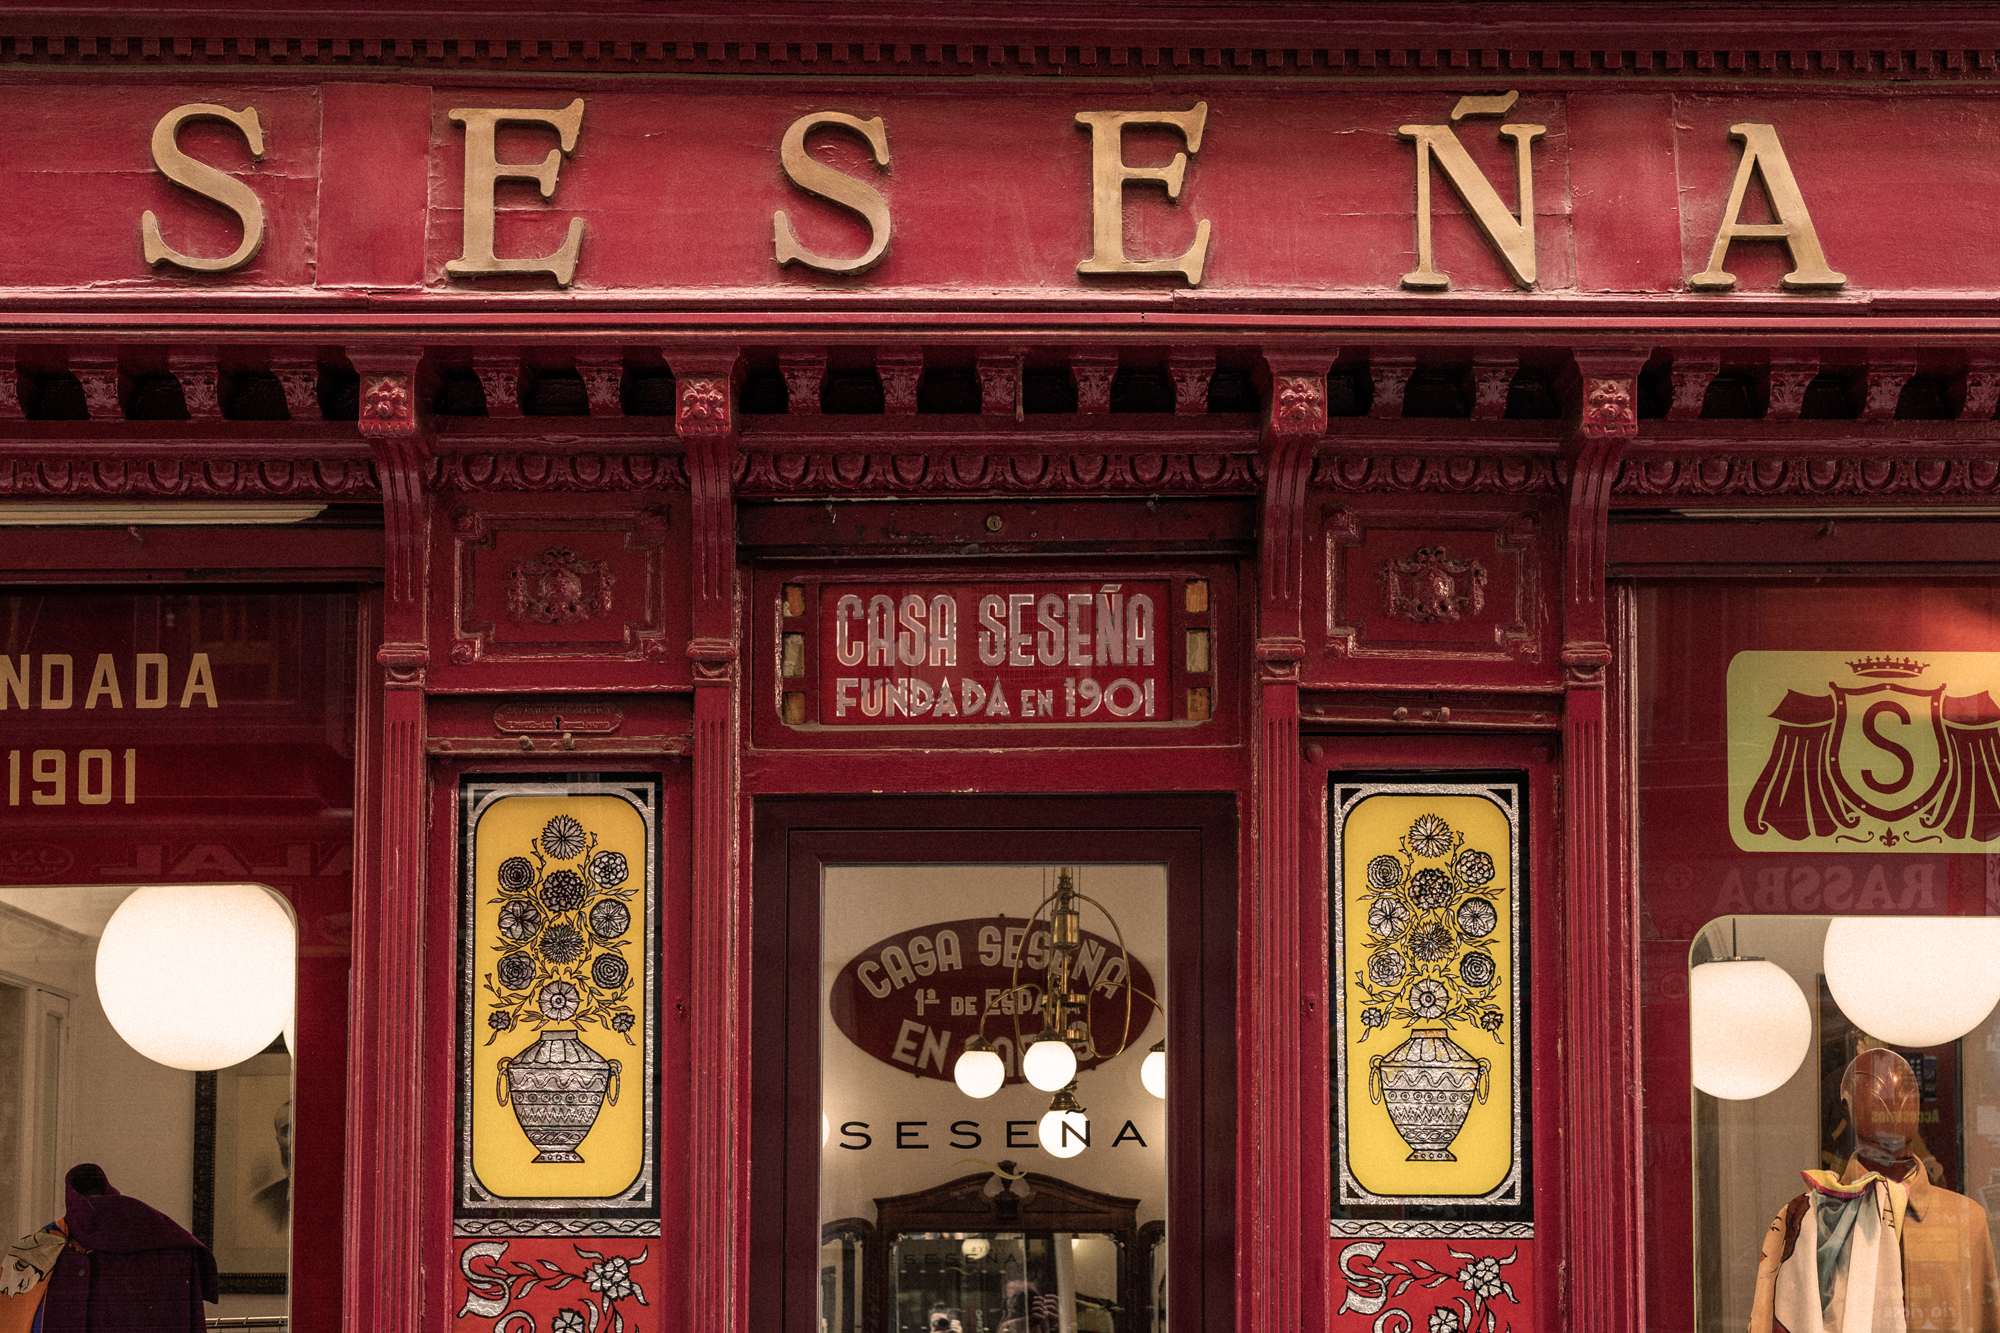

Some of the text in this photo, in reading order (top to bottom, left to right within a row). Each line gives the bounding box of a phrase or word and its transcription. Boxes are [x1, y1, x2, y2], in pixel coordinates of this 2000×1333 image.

[142, 89, 1847, 290] SESEÑA
[836, 584, 1155, 668] CASA SESEÑA
[836, 676, 1155, 718] FUNDADA EN 1901
[1861, 700, 1914, 795] S
[8, 748, 137, 806] 1901
[857, 929, 962, 999] CASA
[951, 996, 977, 1016] DE
[891, 1019, 951, 1074] EN
[839, 1107, 1148, 1150] SESEÑA
